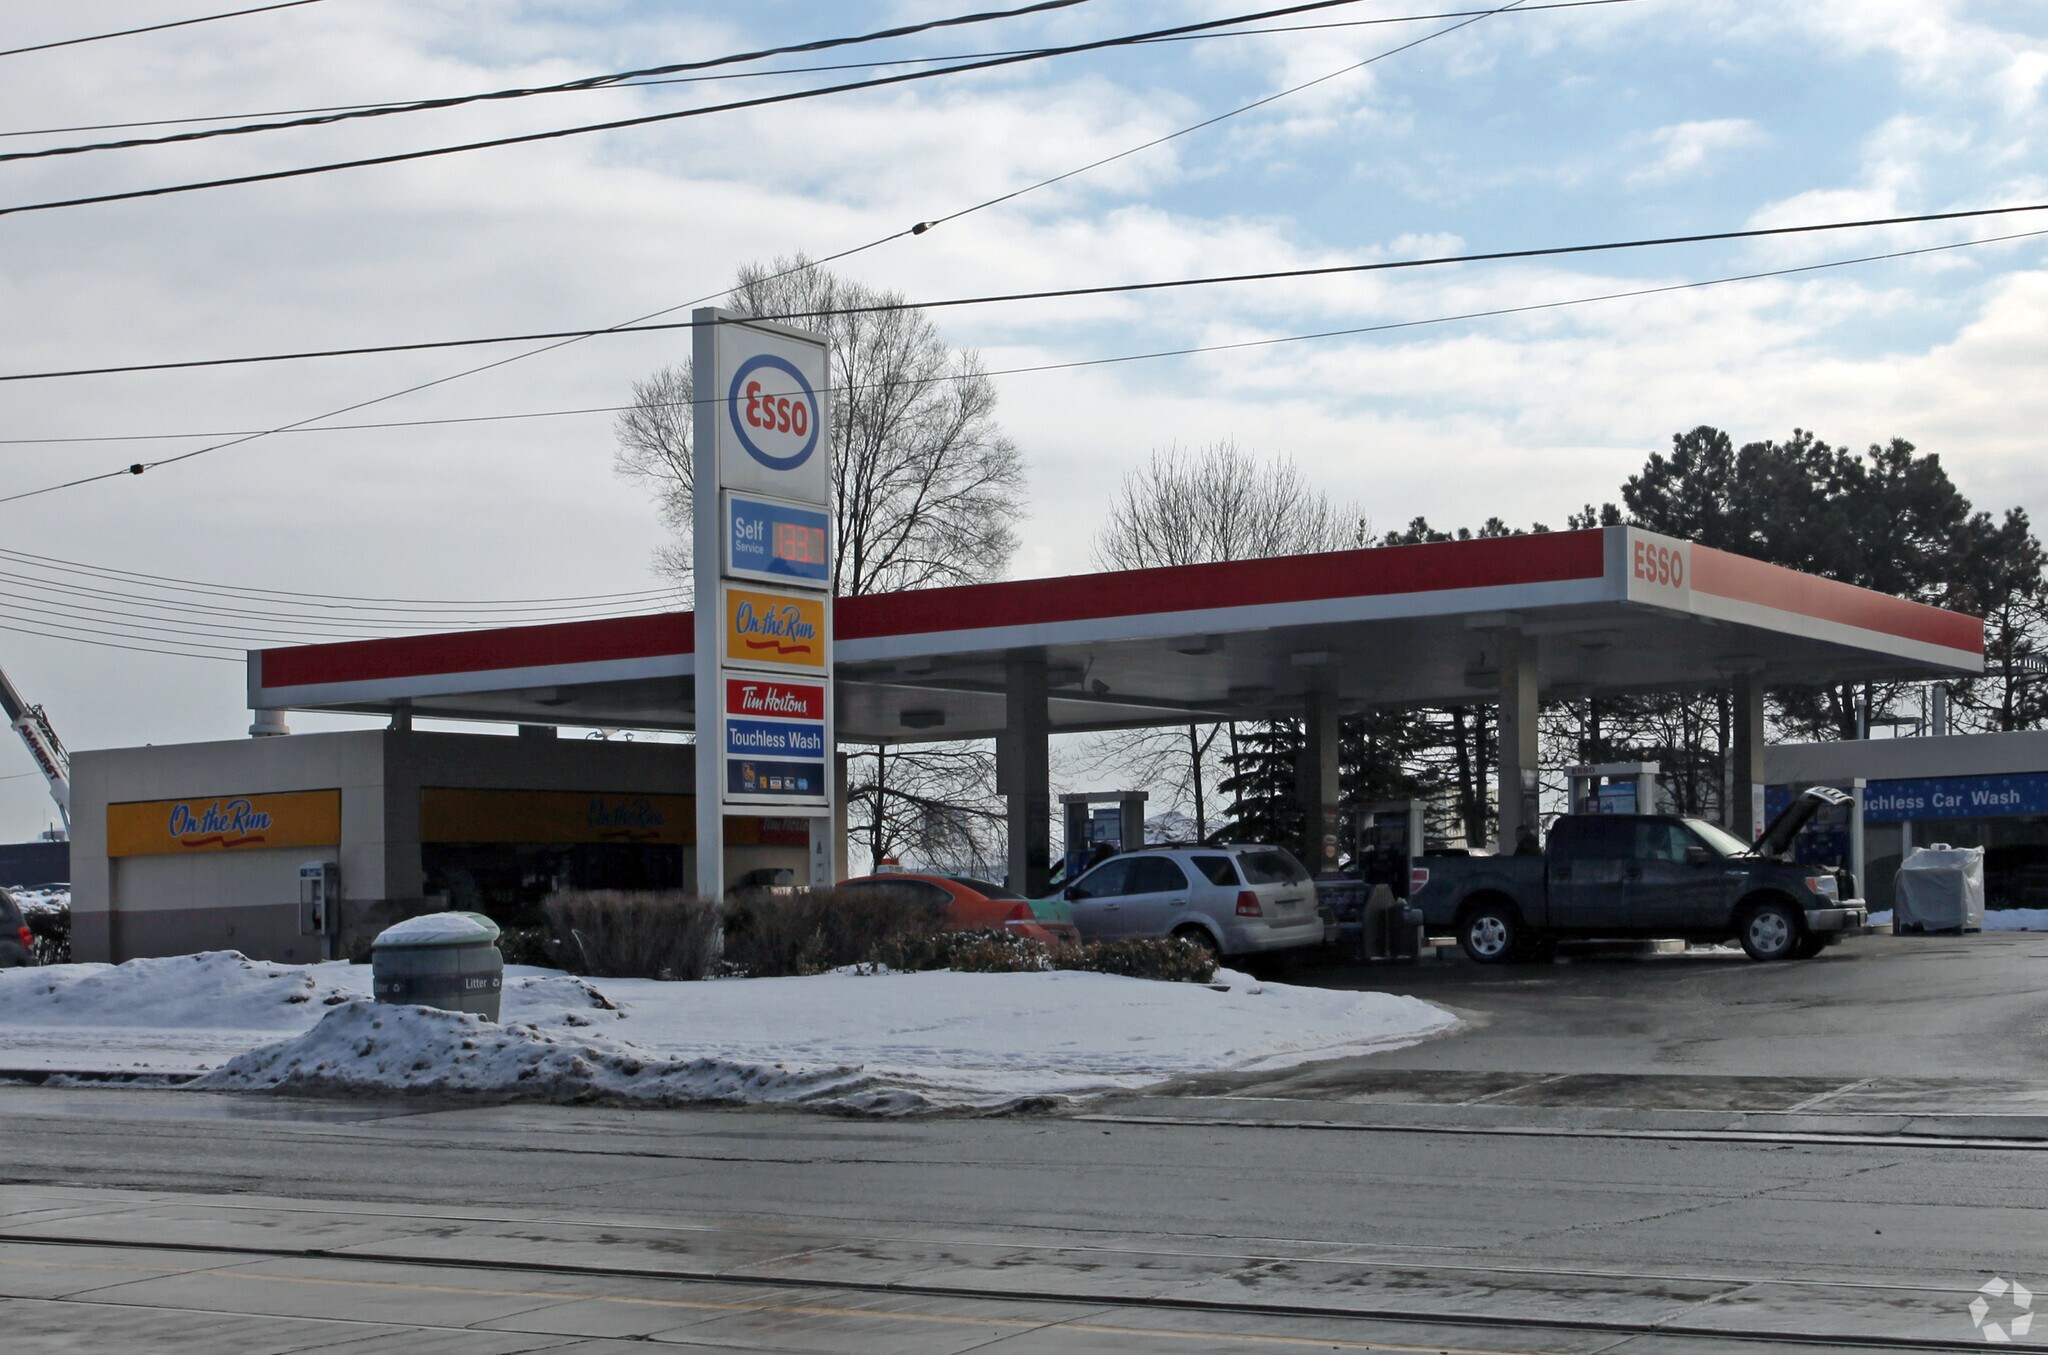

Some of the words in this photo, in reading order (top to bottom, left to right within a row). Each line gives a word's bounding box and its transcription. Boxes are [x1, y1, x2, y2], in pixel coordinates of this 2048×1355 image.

[735, 517, 763, 540] Self
[735, 540, 764, 554] Service
[1634, 540, 1683, 589] ESSO
[736, 601, 759, 634] On
[761, 605, 786, 636] the
[781, 606, 816, 642] Run
[742, 686, 763, 710] Tim
[764, 687, 807, 713] Hortons
[730, 728, 785, 748] Touchless
[788, 732, 821, 749] Wash
[18, 724, 61, 780] AMHERST
[1862, 795, 1925, 810] uchless
[1932, 793, 1963, 808] Car
[1971, 789, 2020, 806] Wash
[169, 803, 200, 837] On
[201, 801, 231, 834] the
[226, 799, 273, 836] Run
[465, 977, 488, 989] Litter
